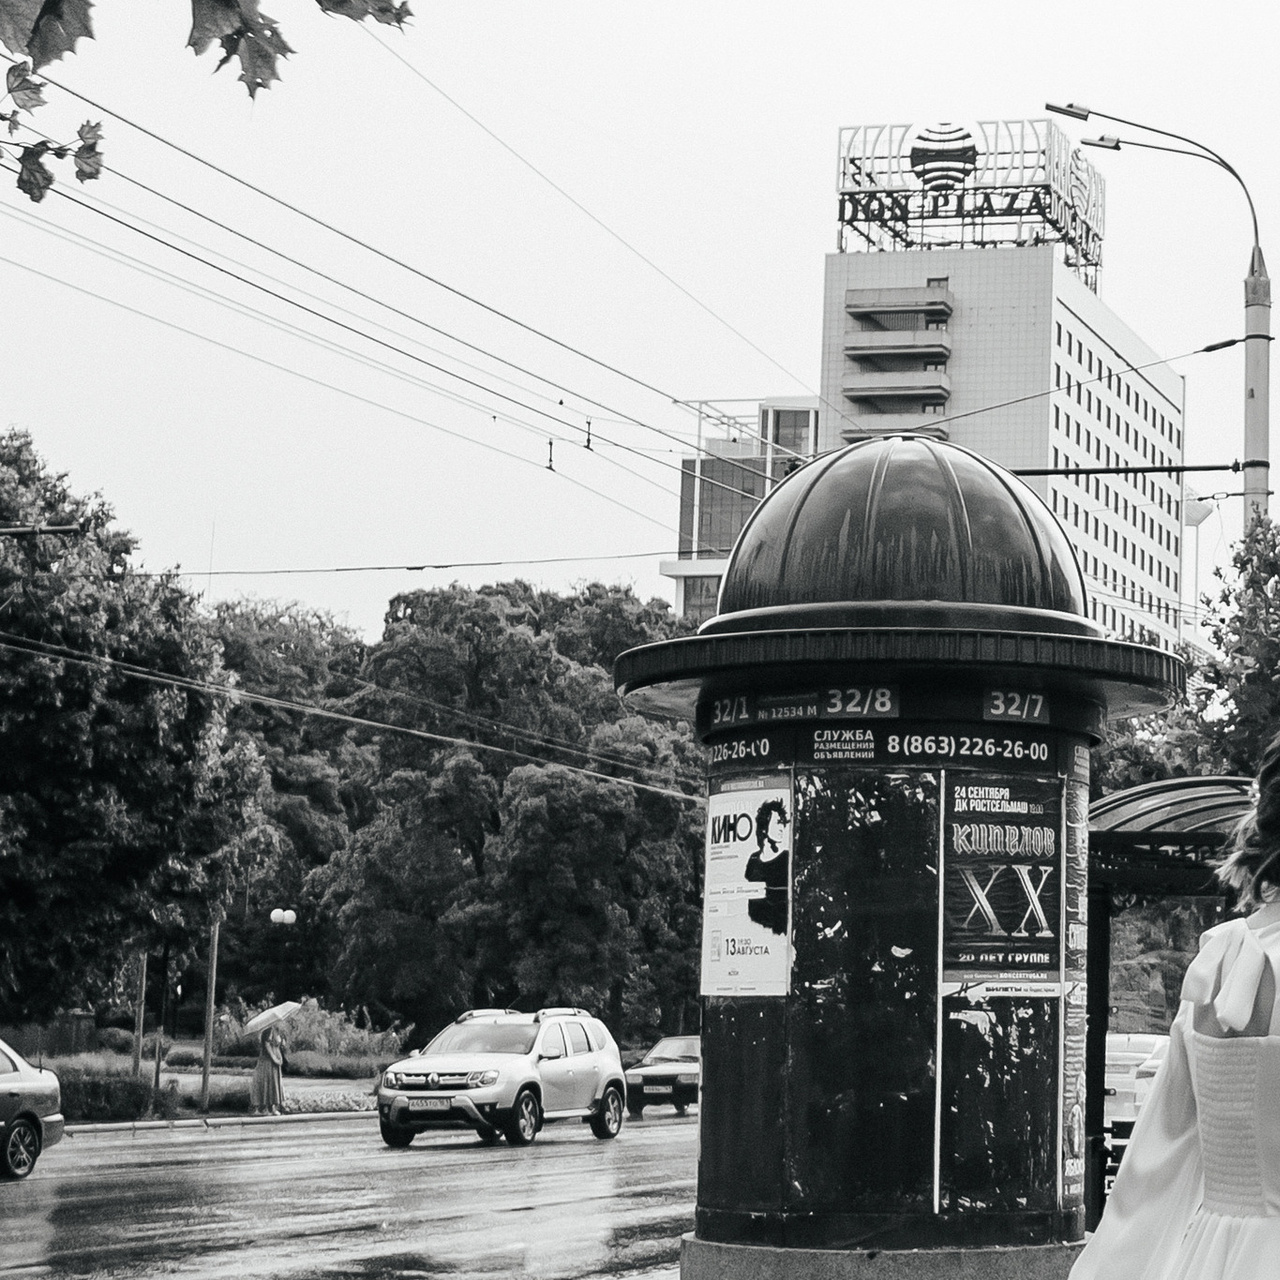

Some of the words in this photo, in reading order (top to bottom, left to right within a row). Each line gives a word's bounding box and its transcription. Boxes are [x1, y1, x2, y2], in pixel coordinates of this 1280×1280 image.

[837, 191, 910, 221] DON
[932, 189, 1047, 218] PLAZA
[713, 696, 749, 723] 32/1
[826, 688, 892, 715] 32/8
[990, 691, 1044, 719] 32/7
[771, 707, 803, 719] 12534
[813, 730, 875, 742] СЛУЖБА
[814, 742, 875, 750] РАЗМЕЩЕНИЯ
[959, 737, 1048, 761] 226-26-00
[954, 786, 966, 798] 24
[967, 786, 1010, 800] СЕНТЯБРЯ
[954, 799, 968, 812] ДК
[969, 799, 1028, 814] РОСТСЕЛЬМАШ
[711, 812, 753, 845] КИНО
[725, 938, 736, 956] 13
[736, 945, 770, 956] АВГУСТА
[958, 953, 975, 962] 20
[980, 953, 1005, 962] ЛЕТ
[1008, 953, 1050, 963] ГРУППЕ
